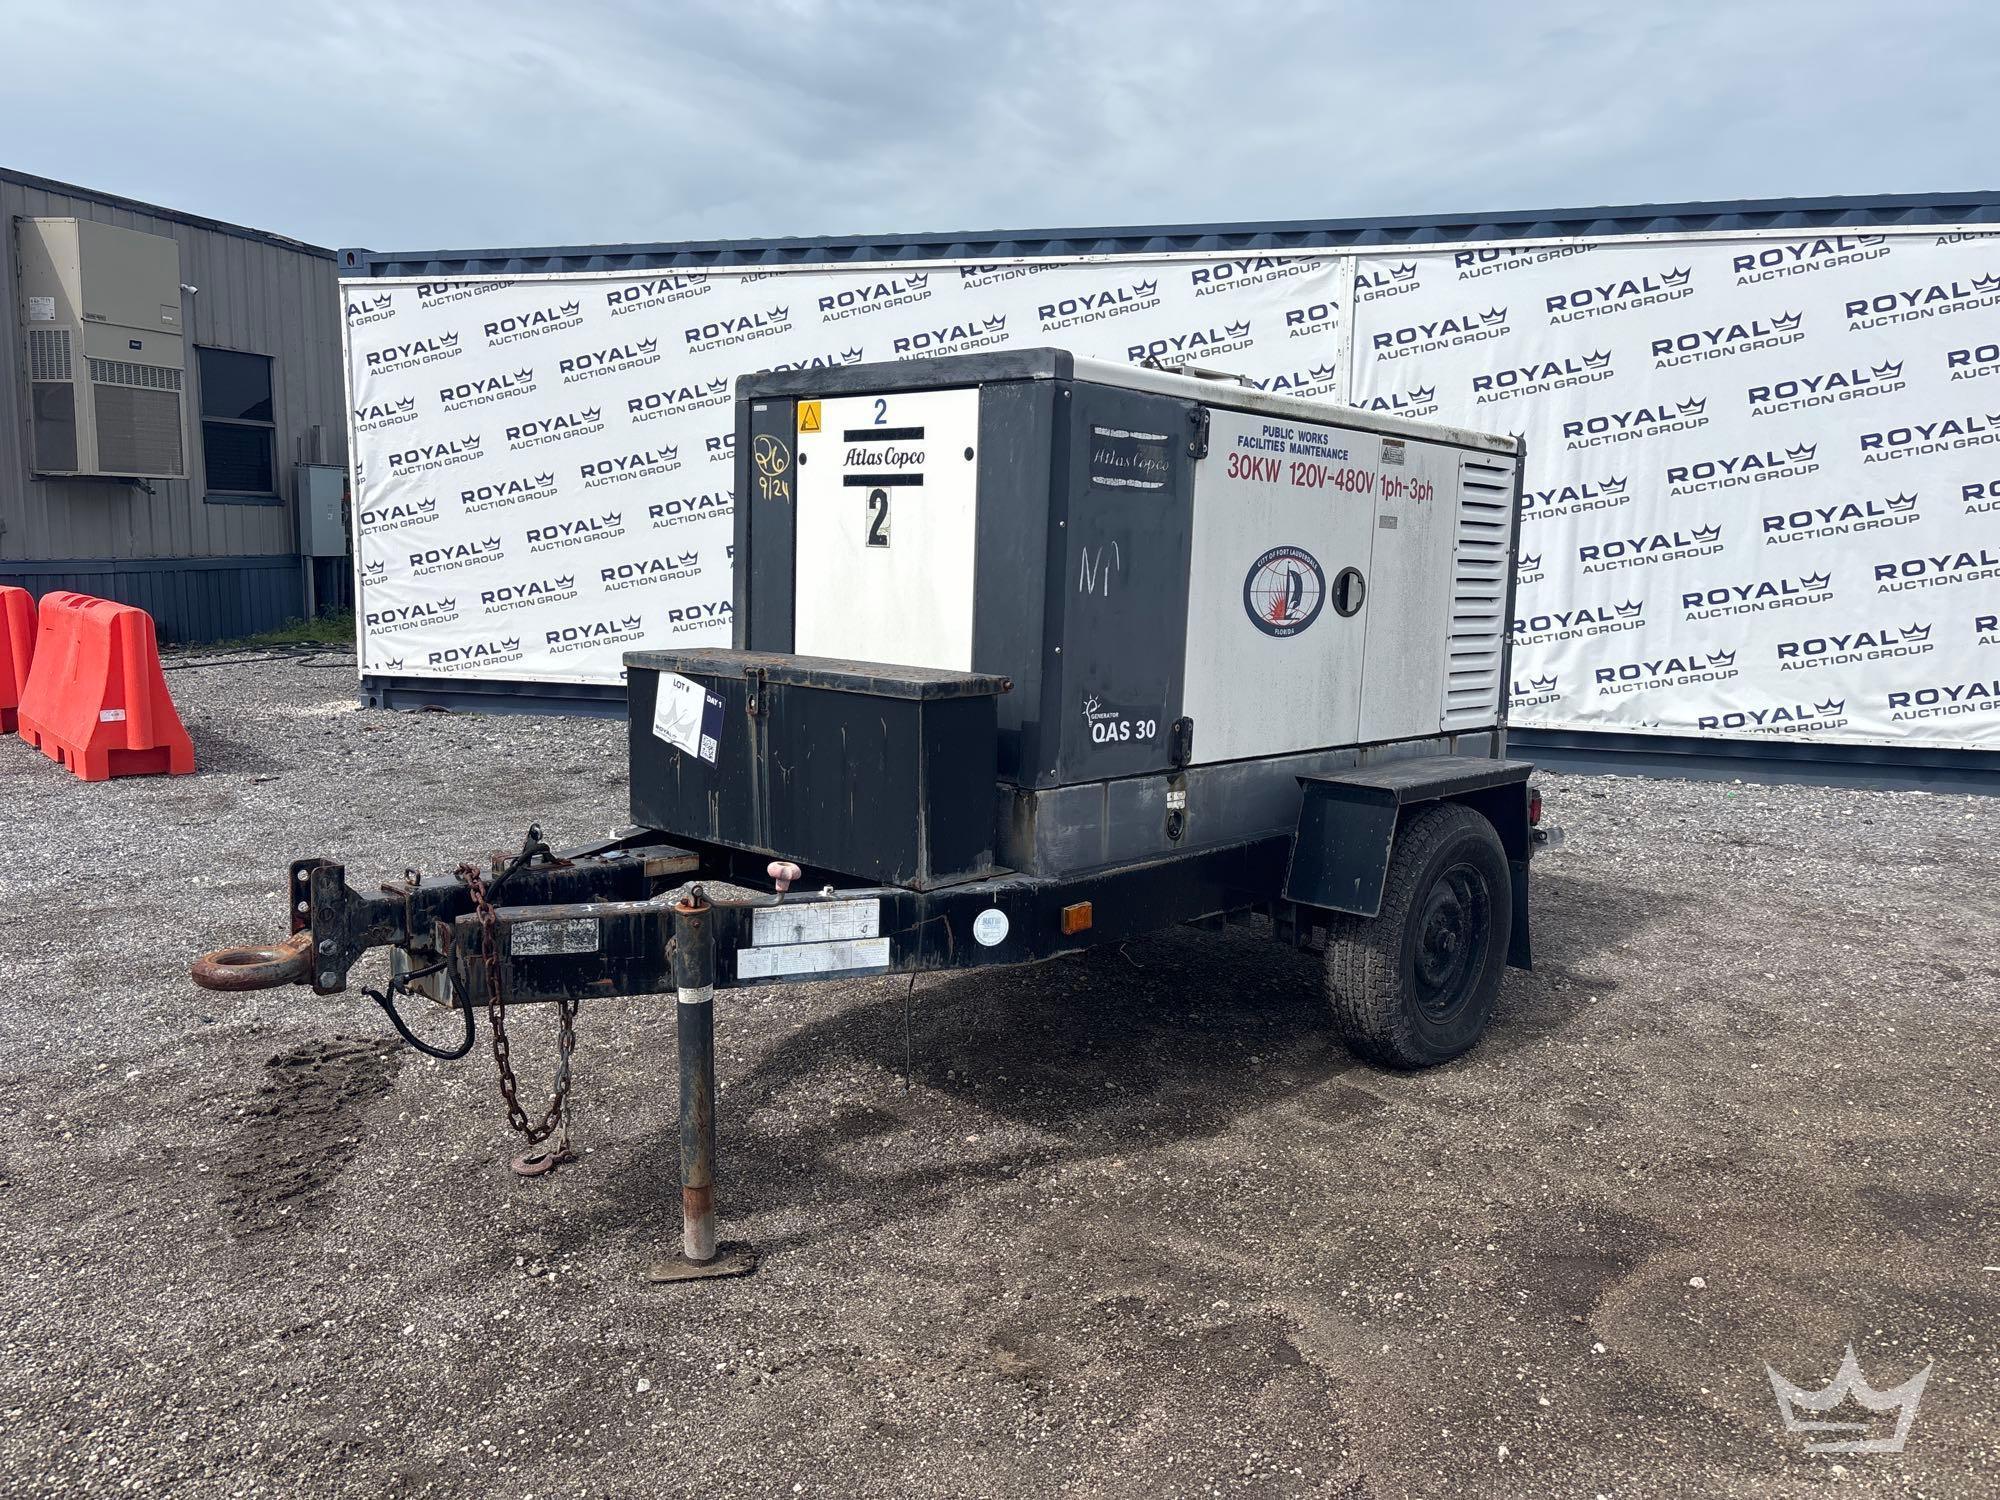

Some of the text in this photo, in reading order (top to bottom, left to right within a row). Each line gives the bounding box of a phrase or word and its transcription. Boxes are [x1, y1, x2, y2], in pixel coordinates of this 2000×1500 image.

[1458, 256, 1534, 281] AUCTION
[1733, 235, 1856, 274] ROYAL
[1736, 247, 1891, 287] AUCTION GROUP
[606, 275, 688, 306] ROYAL
[963, 268, 1026, 290] AUCTION
[1194, 261, 1321, 297] AUCTION GROUP
[1363, 282, 1421, 303] GROUP
[421, 289, 471, 309] AUCTION
[610, 285, 712, 317] AUCTION GROUP
[817, 279, 907, 313] ROYAL
[822, 290, 932, 324] AUCTION GROUP
[1037, 287, 1134, 322] ROYAL
[1545, 276, 1661, 314] ROYAL
[1549, 287, 1695, 326] AUCTION GROUP
[1845, 281, 1972, 320] ROYAL
[355, 309, 396, 327] GROUP
[483, 307, 562, 338] ROYAL
[684, 313, 769, 345] ROYAL
[1041, 297, 1161, 333] AUCTION GROUP
[1848, 307, 1935, 332] AUCTION
[487, 317, 584, 348] AUCTION GROUP
[688, 322, 793, 355] AUCTION GROUP
[893, 322, 984, 354] ROYAL
[960, 332, 1010, 351] GROUP
[1372, 315, 1480, 351] ROYAL
[1376, 326, 1511, 363] AUCTION GROUP
[1651, 320, 1771, 358] ROYAL
[365, 338, 441, 367] ROYAL
[370, 347, 463, 377] AUCTION GROUP
[558, 344, 638, 375] ROYAL
[1200, 338, 1254, 358] GROUP
[1654, 332, 1806, 370] AUCTION GROUP
[563, 354, 662, 385] AUCTION GROUP
[1472, 358, 1583, 393] ROYAL
[439, 374, 516, 403] ROYAL
[443, 383, 537, 413] AUCTION GROUP
[627, 384, 709, 414] ROYAL
[1475, 369, 1615, 405] AUCTION GROUP
[1747, 368, 1872, 405] ROYAL
[1751, 380, 1907, 418] AUCTION GROUP
[378, 412, 419, 428] GROUP
[631, 394, 732, 424] AUCTION GROUP
[873, 398, 888, 425] 2
[1562, 404, 1677, 439] ROYAL
[505, 413, 583, 442] ROYAL
[509, 423, 605, 452] AUCTION GROUP
[1262, 425, 1329, 445] PUBLIC WORKS
[1566, 416, 1710, 452] AUCTION GROUP
[1859, 416, 1986, 452] ROYAL
[388, 441, 462, 468] ROYAL
[843, 446, 926, 468] Atlas Copco
[1237, 435, 1349, 461] FACILITIES MAINTENANCE
[1863, 441, 1950, 465] AUCTION
[392, 450, 484, 478] AUCTION GROUP
[579, 451, 660, 479] ROYAL
[584, 461, 682, 489] AUCTION GROUP
[1227, 452, 1434, 504] 30KW 120V-480V 1ph-3ph
[1666, 450, 1786, 485] ROYAL
[460, 477, 537, 505] ROYAL
[1670, 463, 1820, 497] AUCTION GROUP
[464, 487, 558, 515] AUCTION GROUP
[648, 492, 729, 519] ROYAL
[1571, 495, 1630, 513] GROUP
[400, 513, 440, 528] GROUP
[525, 517, 604, 544] ROYAL
[652, 512, 706, 530] AUCTION
[868, 487, 888, 546] 2
[1762, 500, 1886, 534] ROYAL
[1765, 513, 1921, 546] AUCTION GROUP
[408, 541, 484, 568] ROYAL
[529, 527, 626, 554] AUCTION GROUP
[1578, 531, 1692, 563] ROYAL
[412, 552, 505, 577] AUCTION GROUP
[600, 556, 679, 583] ROYAL
[1582, 544, 1725, 575] AUCTION GROUP
[1873, 549, 2000, 582] ROYAL
[480, 579, 557, 605] ROYAL
[604, 567, 702, 593] AUCTION GROUP
[1681, 578, 1800, 610] ROYAL
[1876, 573, 1963, 595] AUCTION
[365, 602, 439, 627] ROYAL
[484, 590, 578, 615] AUCTION GROUP
[1685, 592, 1834, 622] AUCTION GROUP
[369, 612, 460, 636] AUCTION GROUP
[545, 620, 623, 645] ROYAL
[671, 617, 726, 633] AUCTION
[1586, 619, 1646, 637] GROUP
[428, 642, 502, 666] ROYAL
[549, 631, 645, 655] AUCTION GROUP
[1776, 629, 1900, 660] ROYAL
[1780, 643, 1935, 672] AUCTION GROUP
[483, 652, 523, 666] GROUP
[1594, 655, 1707, 685] ROYAL
[673, 679, 685, 690] LOT
[1598, 669, 1739, 697] AUCTION GROUP
[706, 695, 718, 705] DAY
[1891, 703, 1976, 722] AUCTION
[1090, 712, 1119, 720] GENERATOR
[1698, 705, 1815, 731] ROYAL
[1783, 719, 1848, 734] GROUP
[1092, 719, 1156, 743] QAS 30
